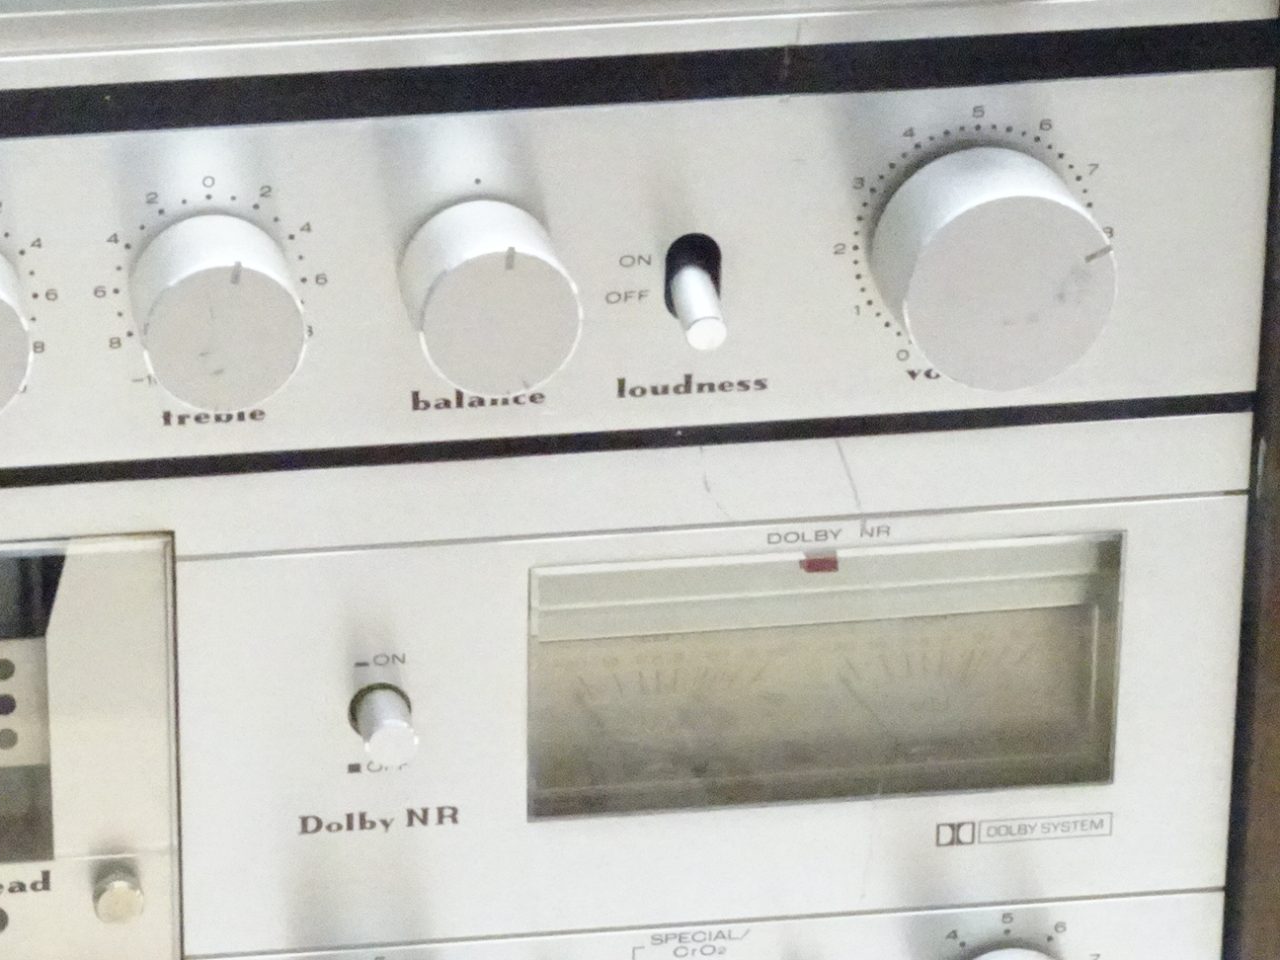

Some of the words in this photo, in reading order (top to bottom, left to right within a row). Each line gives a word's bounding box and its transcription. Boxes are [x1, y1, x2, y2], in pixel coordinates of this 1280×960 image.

[972, 106, 985, 118] 5
[1039, 119, 1052, 131] 6
[902, 127, 915, 139] 4
[1088, 163, 1099, 176] 7
[201, 175, 215, 188] 0
[853, 177, 865, 190] 3
[259, 185, 273, 198] 2
[145, 192, 159, 205] 2
[299, 222, 313, 235] 4
[29, 237, 44, 250] 4
[106, 233, 120, 245] 4
[833, 243, 846, 255] 2
[619, 254, 652, 268] ON
[314, 273, 328, 286] 6
[45, 288, 60, 302] 6
[93, 286, 107, 299] 6
[605, 290, 650, 304] OFF
[853, 304, 861, 316] 1
[32, 340, 46, 354] 8
[109, 336, 122, 350] 8
[896, 349, 910, 362] 0
[616, 373, 769, 399] loudness
[411, 388, 546, 411] balance
[766, 528, 842, 546] DOLBY
[860, 524, 891, 539] NR
[372, 652, 406, 666] ON
[298, 811, 395, 836] Dolby
[406, 806, 460, 828] NR
[986, 823, 1038, 838] DOLBY
[1041, 818, 1104, 833] SYSTEM
[1001, 912, 1014, 924] 5
[1054, 921, 1067, 933] 6
[945, 929, 958, 940] 4
